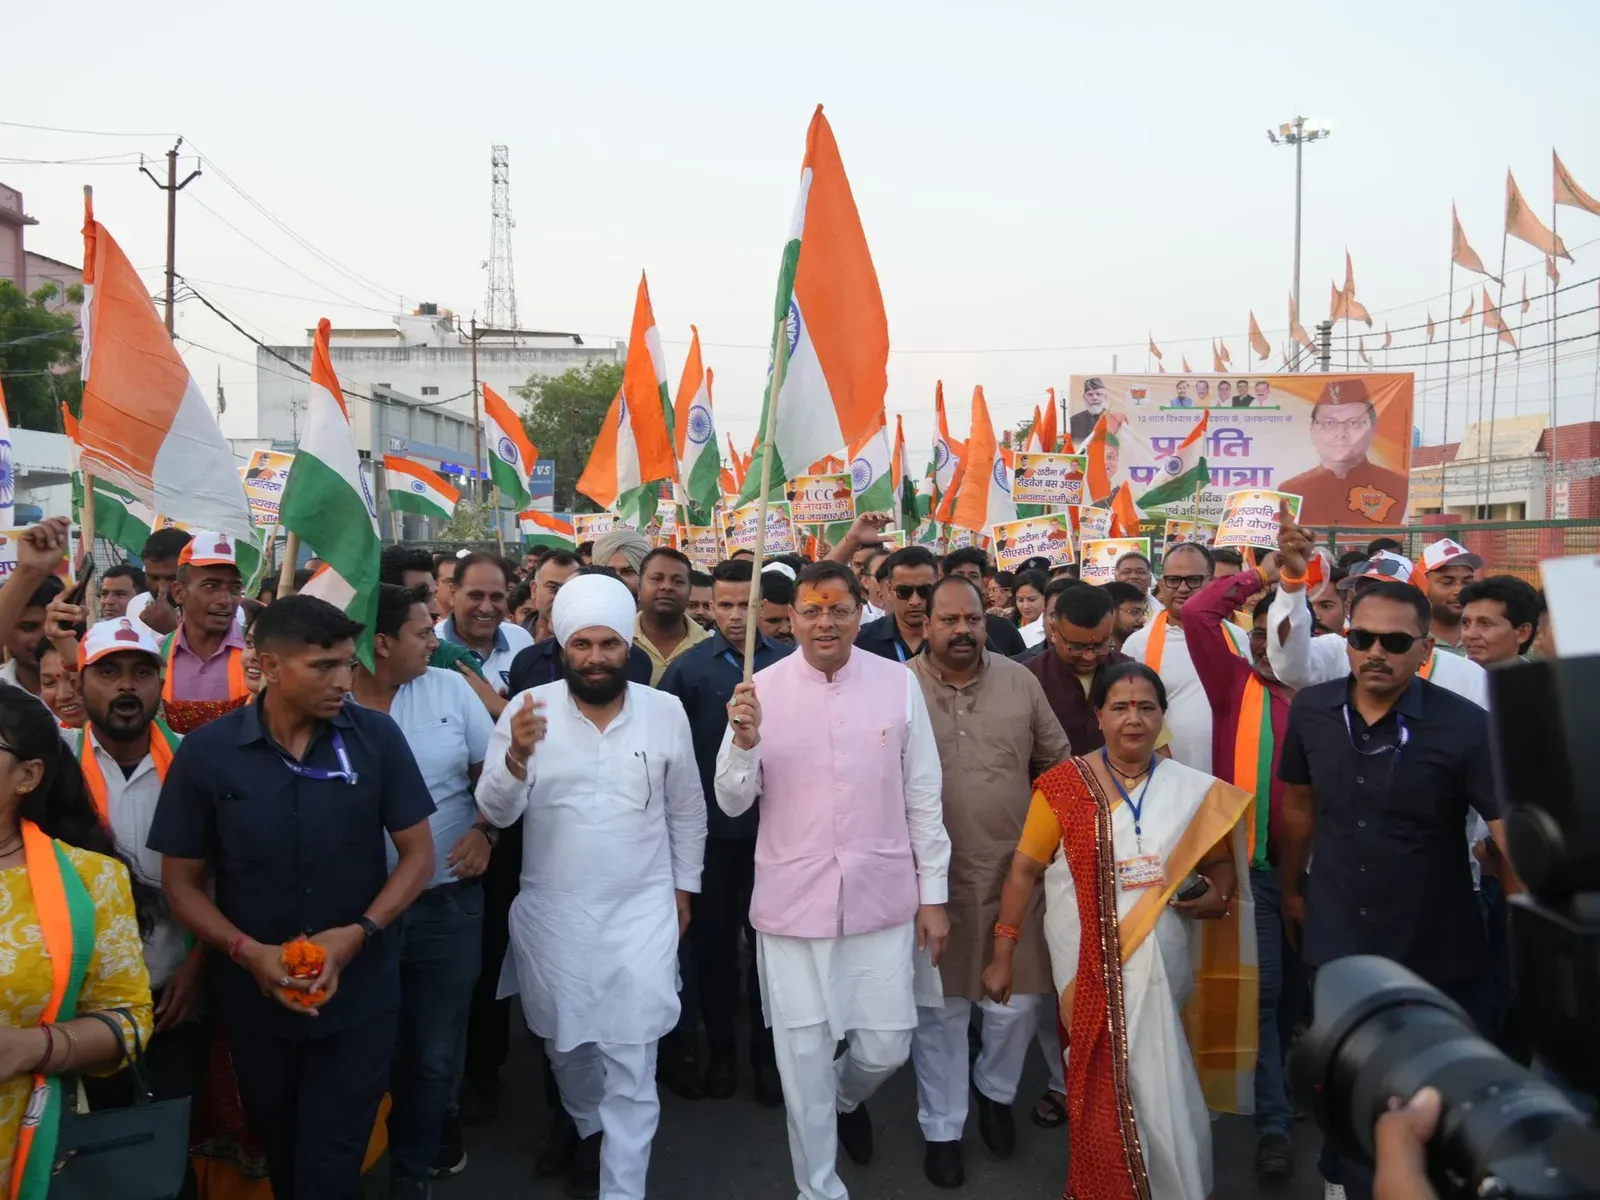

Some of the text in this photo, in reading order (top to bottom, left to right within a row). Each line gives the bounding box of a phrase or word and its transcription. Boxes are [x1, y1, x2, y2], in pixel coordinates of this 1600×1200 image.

[1150, 427, 1253, 461] प्रति
[1045, 479, 1057, 488] बस
[805, 488, 833, 501] UCC
[1237, 505, 1274, 517] लखपति
[1246, 518, 1280, 530] योजन
